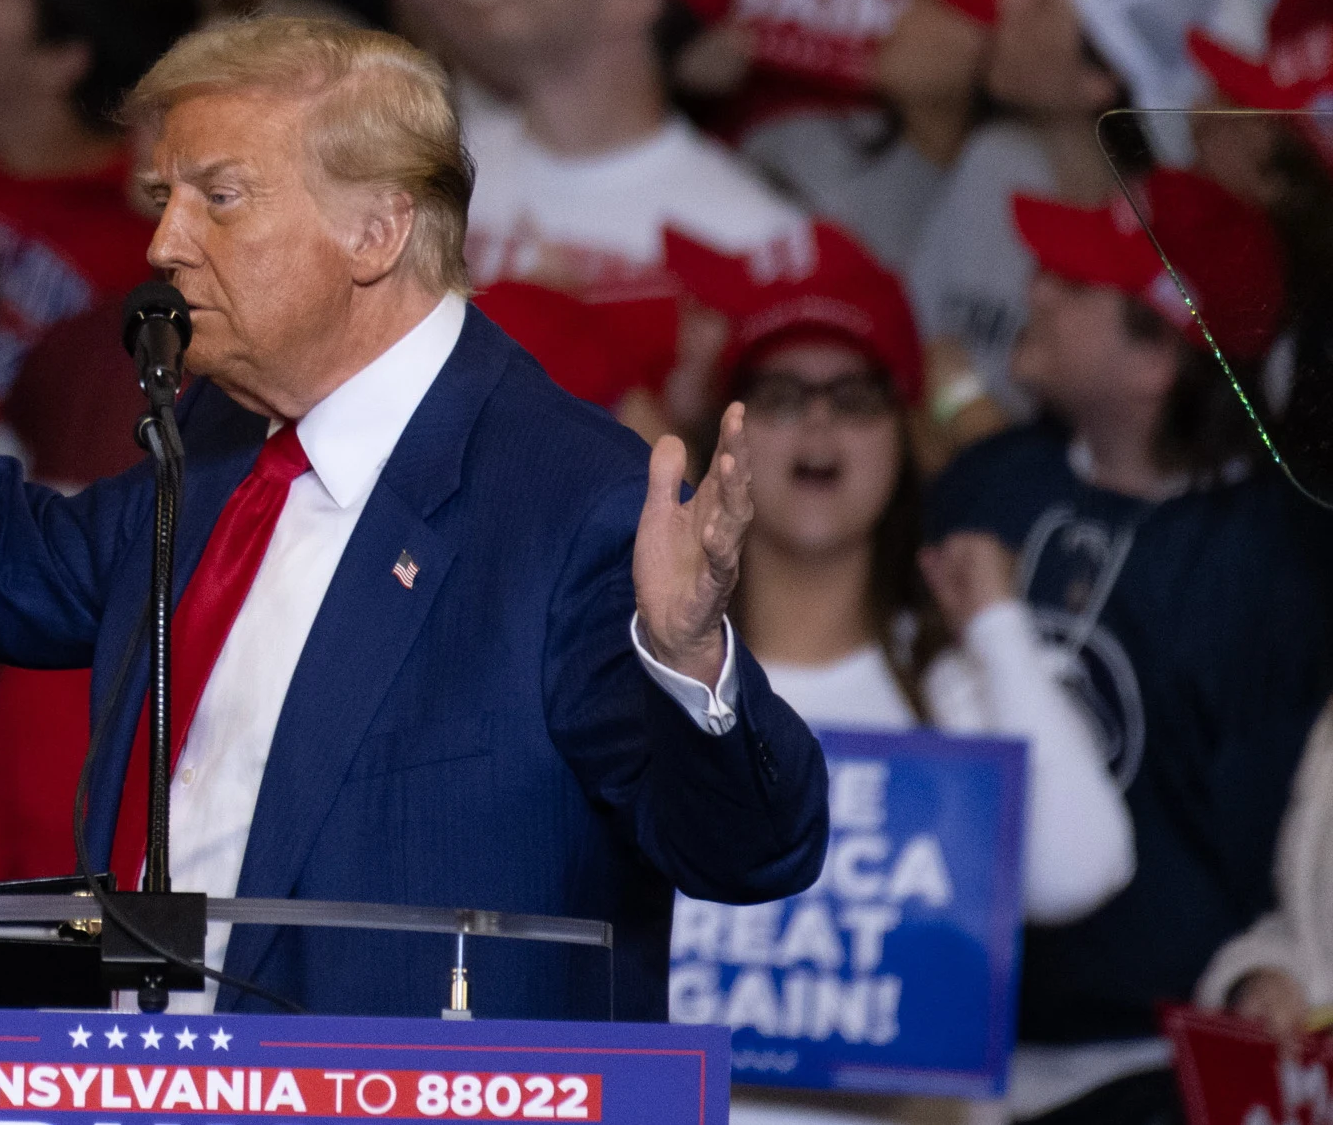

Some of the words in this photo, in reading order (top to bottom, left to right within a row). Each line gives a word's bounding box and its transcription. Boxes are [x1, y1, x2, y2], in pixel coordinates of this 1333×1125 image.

[670, 897, 901, 973] REAT
[668, 965, 904, 1047] GAIN!
[323, 1072, 397, 1115] TO
[416, 1074, 589, 1119] 88022
